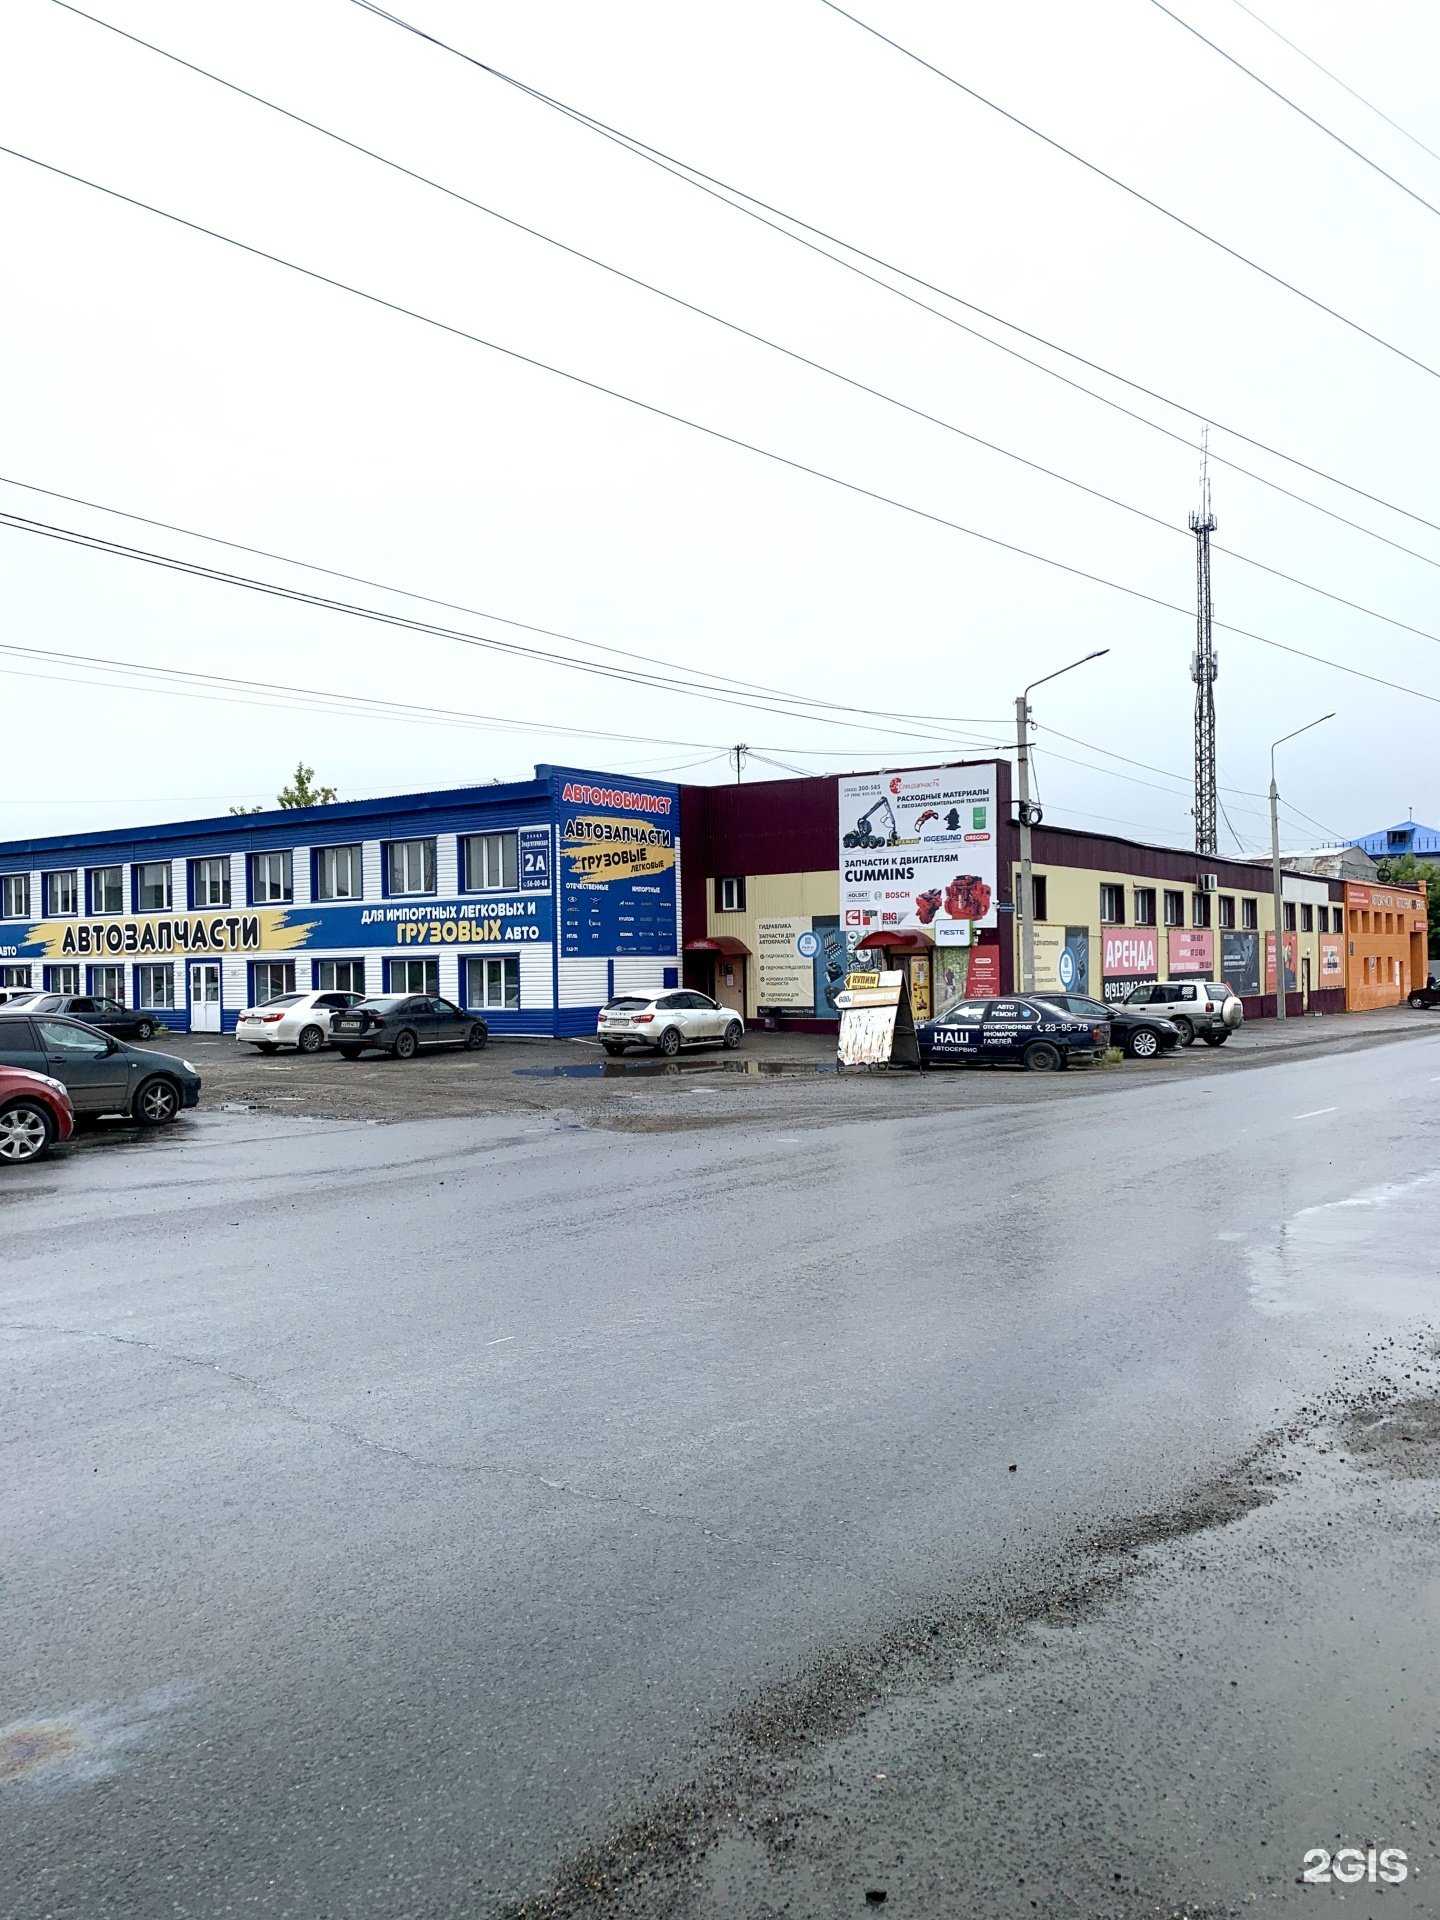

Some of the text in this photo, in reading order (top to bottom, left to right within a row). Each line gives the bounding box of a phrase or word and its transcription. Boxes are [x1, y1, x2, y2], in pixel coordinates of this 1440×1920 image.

[562, 783, 672, 814] АВТОМОБИЛИСТ
[896, 788, 990, 802] РАСХОДНЫЕ МАТЕРИАЛЫ
[901, 800, 965, 808] ЛЕСОЗАГОТОВИТЕЛЬНОЙ
[564, 819, 671, 846] АВТОЗАПЧАСТИ
[525, 854, 546, 872] 2А
[580, 848, 648, 870] ГРУЗОВЫЕ
[630, 860, 664, 872] ЛЕГКОВЫЕ
[844, 854, 958, 868] ЗАПЧАСТИ К ДВИГАТЕЛЯМ
[844, 867, 914, 882] CUMMINS
[566, 882, 609, 891] ОТЕЧЕСТВЕННЫЕ
[361, 902, 536, 924] ДЛЯ ИМПОРТНЫХ ЛЕГКОВЫХ И
[882, 912, 897, 920] BIG
[62, 916, 260, 954] АВТОЗАПЧАСТИ
[397, 920, 539, 944] ГРУЗОВЫХ АВТО
[1106, 940, 1154, 970] АРЕНДА
[1045, 1024, 1088, 1032] 23-95-75
[934, 1032, 969, 1044] НАШ
[932, 1045, 978, 1053] АВТОСЕРВИС
